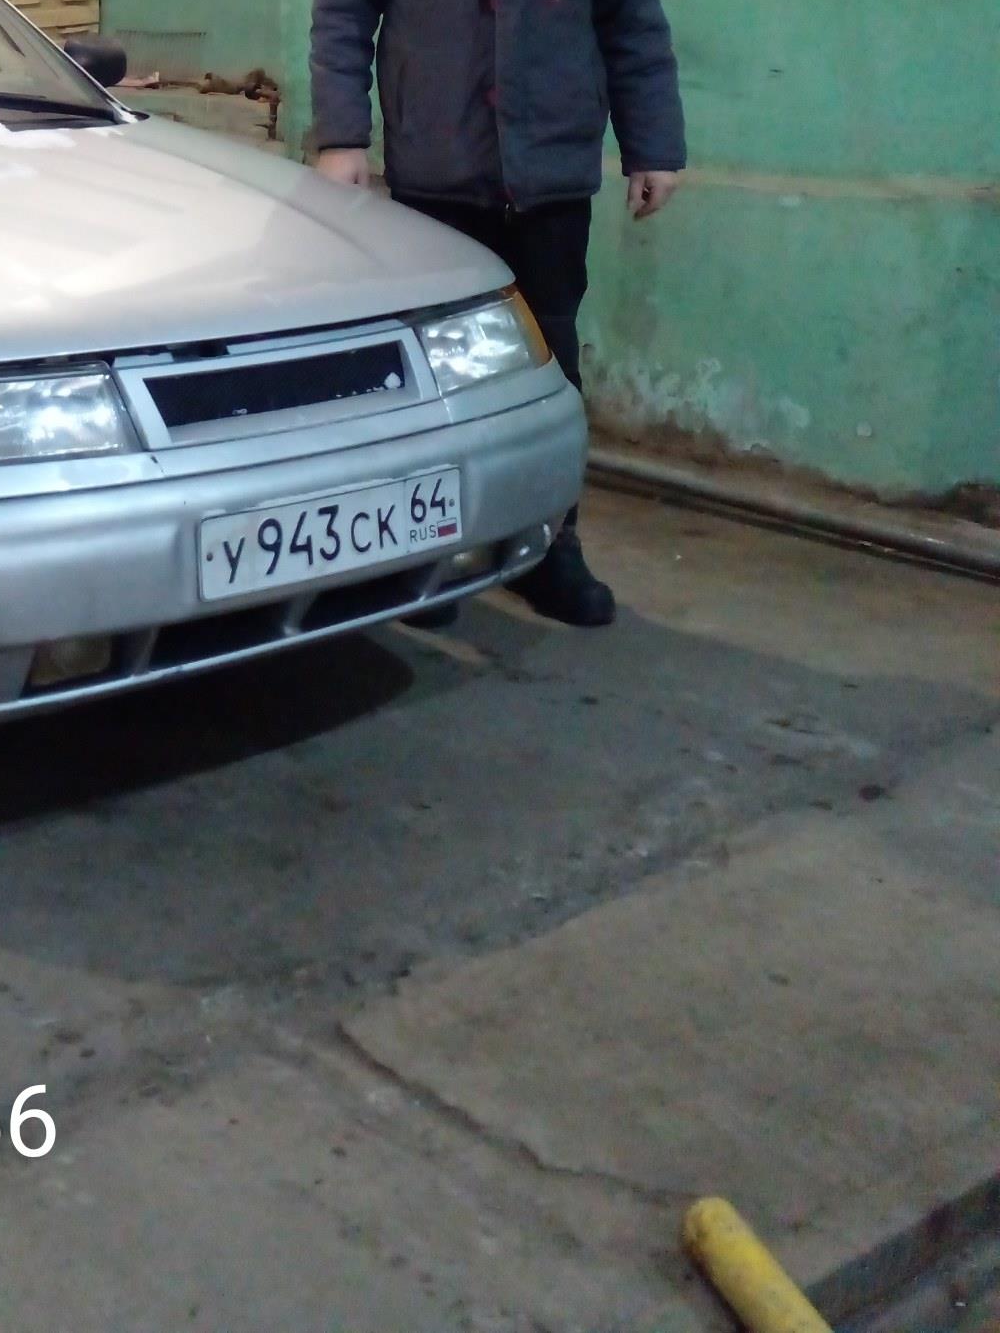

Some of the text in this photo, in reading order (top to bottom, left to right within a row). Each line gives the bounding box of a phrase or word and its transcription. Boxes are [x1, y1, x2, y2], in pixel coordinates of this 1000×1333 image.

[222, 477, 447, 584] У943СК 64
[409, 524, 437, 543] RUS
